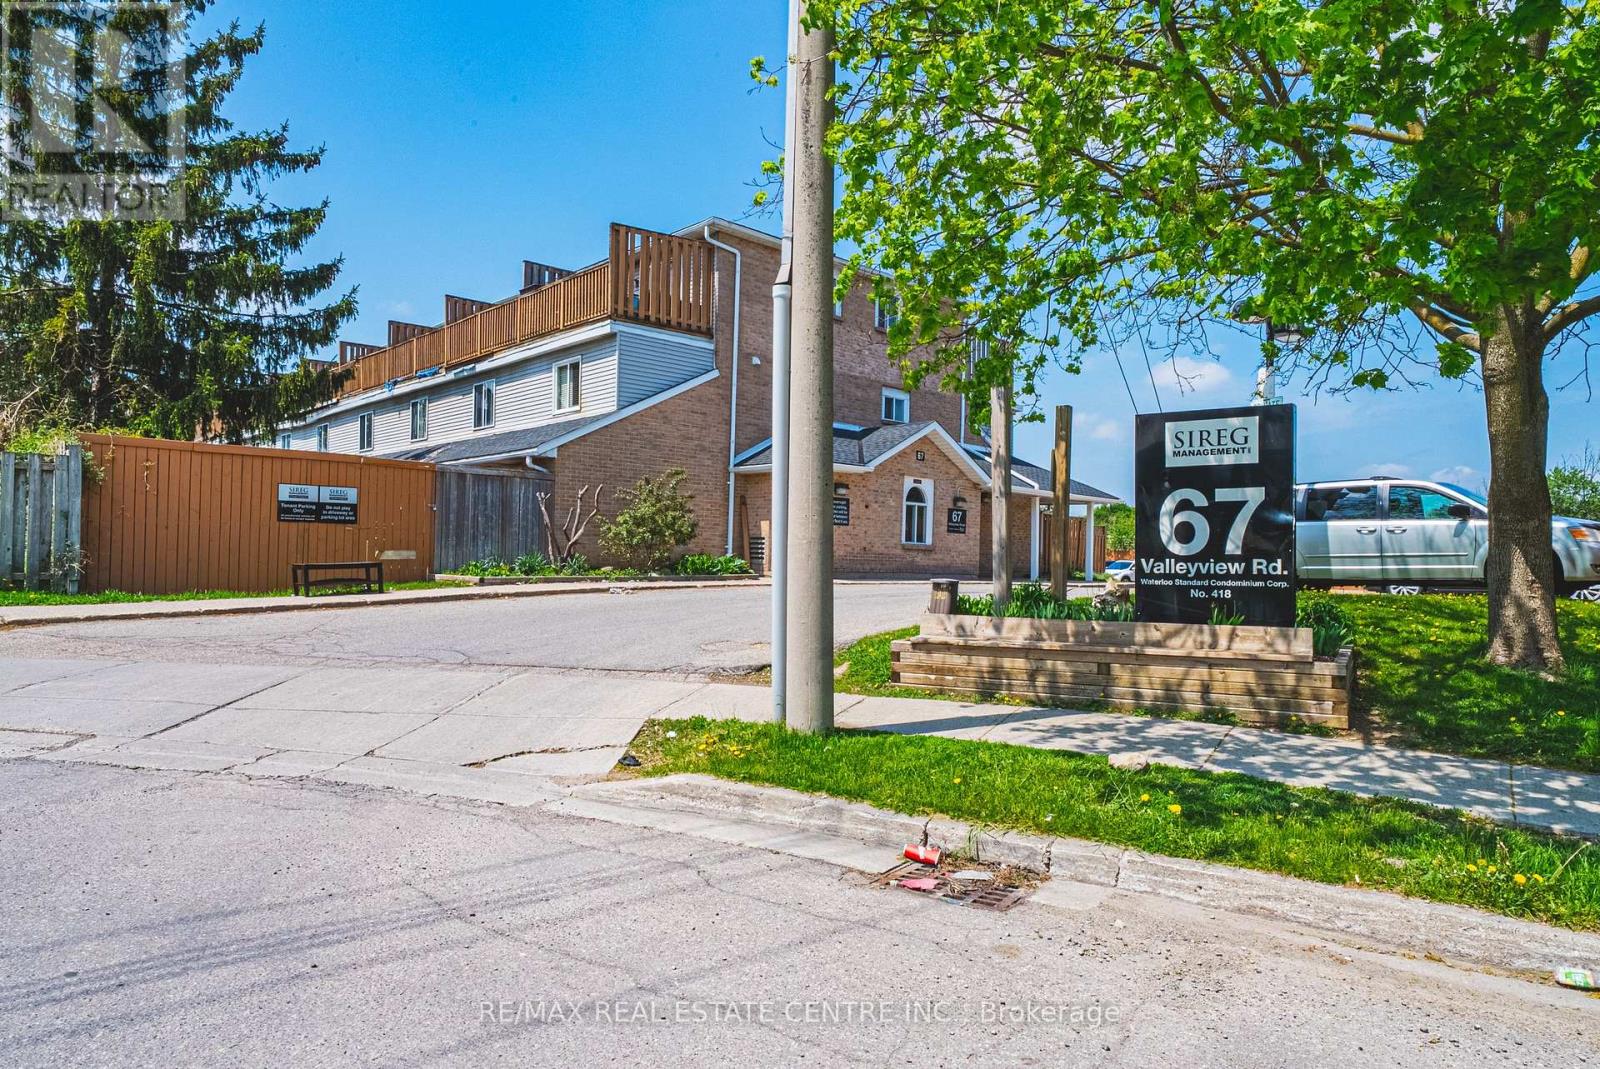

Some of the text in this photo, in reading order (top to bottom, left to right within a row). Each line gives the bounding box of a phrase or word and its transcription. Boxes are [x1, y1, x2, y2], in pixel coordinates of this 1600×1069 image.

[1173, 426, 1249, 449] SIREG
[1172, 447, 1247, 458] MANAGEMENT
[952, 511, 962, 522] 67
[1159, 486, 1266, 556] 67
[1140, 558, 1288, 577] Valleyview Rd.
[1140, 578, 1173, 586] Waterloo
[1210, 579, 1265, 587] Condominium
[1266, 580, 1290, 588] Corp.
[1190, 589, 1232, 598] No. 418
